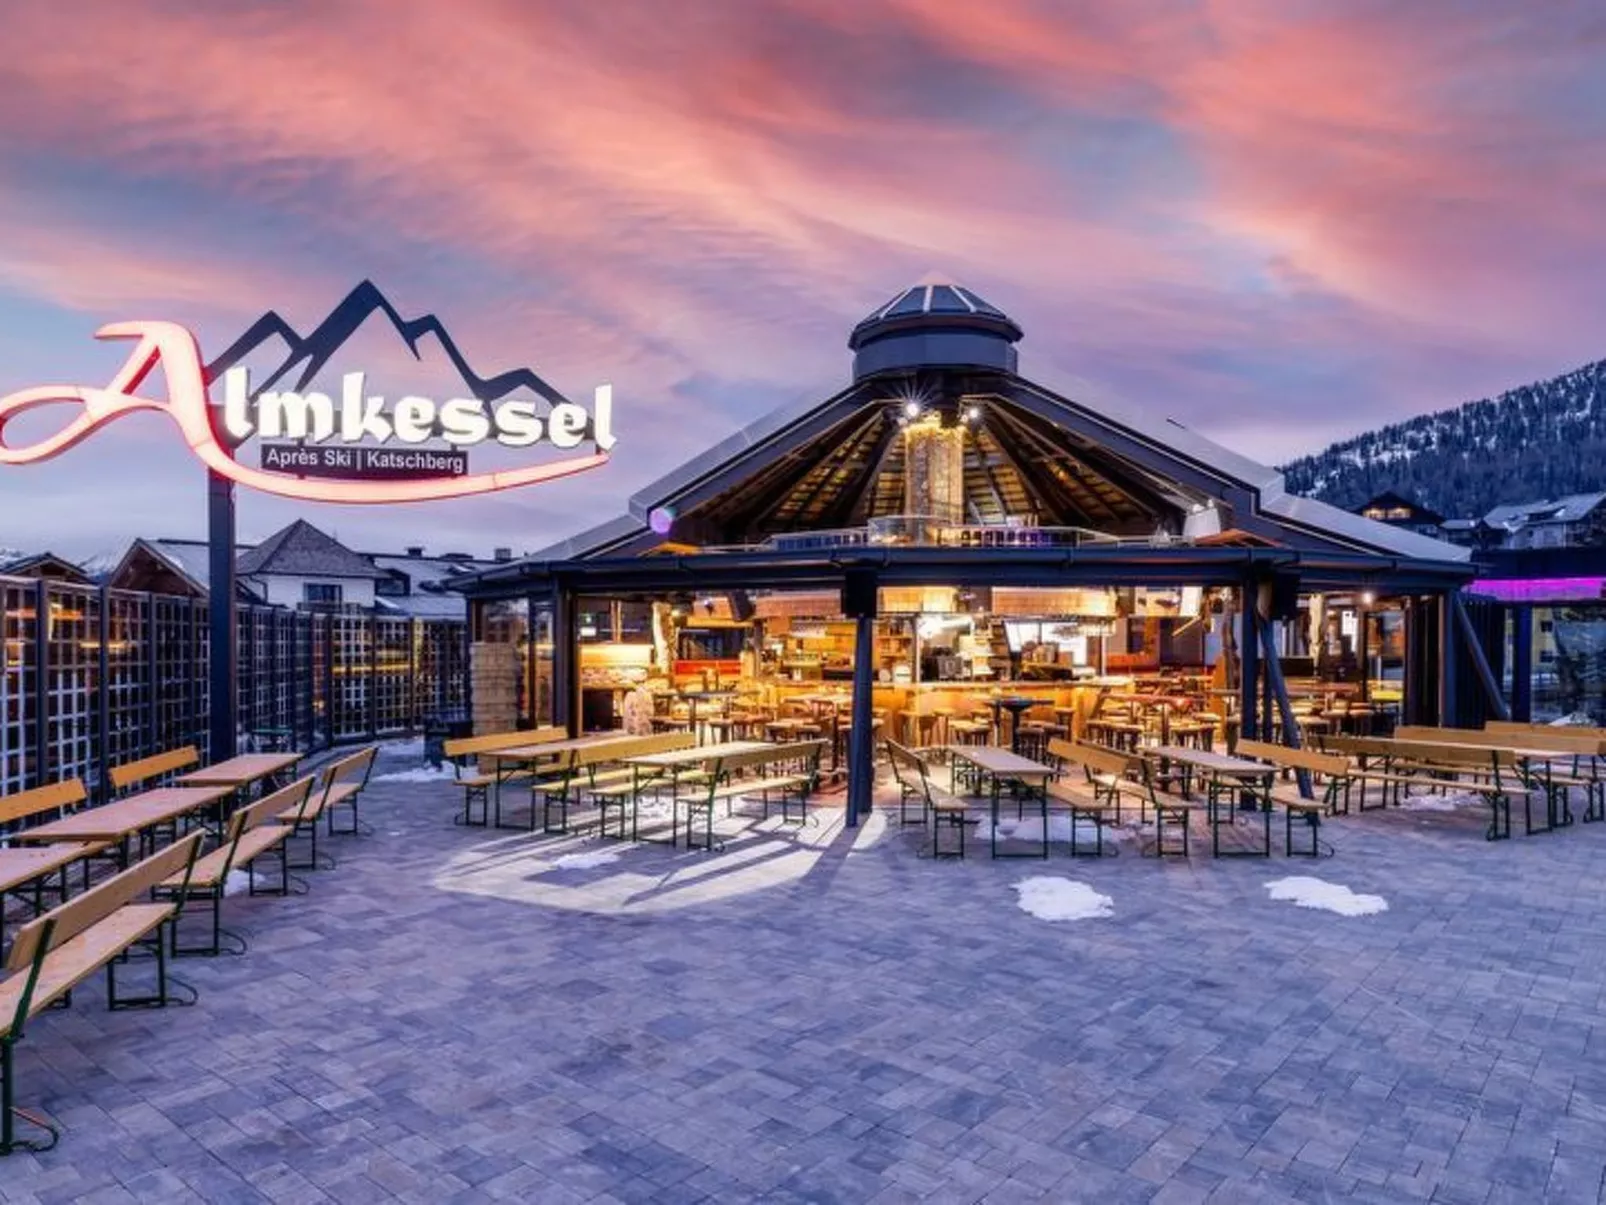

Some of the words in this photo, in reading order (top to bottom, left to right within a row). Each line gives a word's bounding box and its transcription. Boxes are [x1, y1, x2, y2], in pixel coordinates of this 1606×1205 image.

[0, 320, 617, 503] Almkessel
[266, 448, 318, 468] Après
[324, 449, 351, 467] Ski
[366, 451, 464, 474] Katschberg
